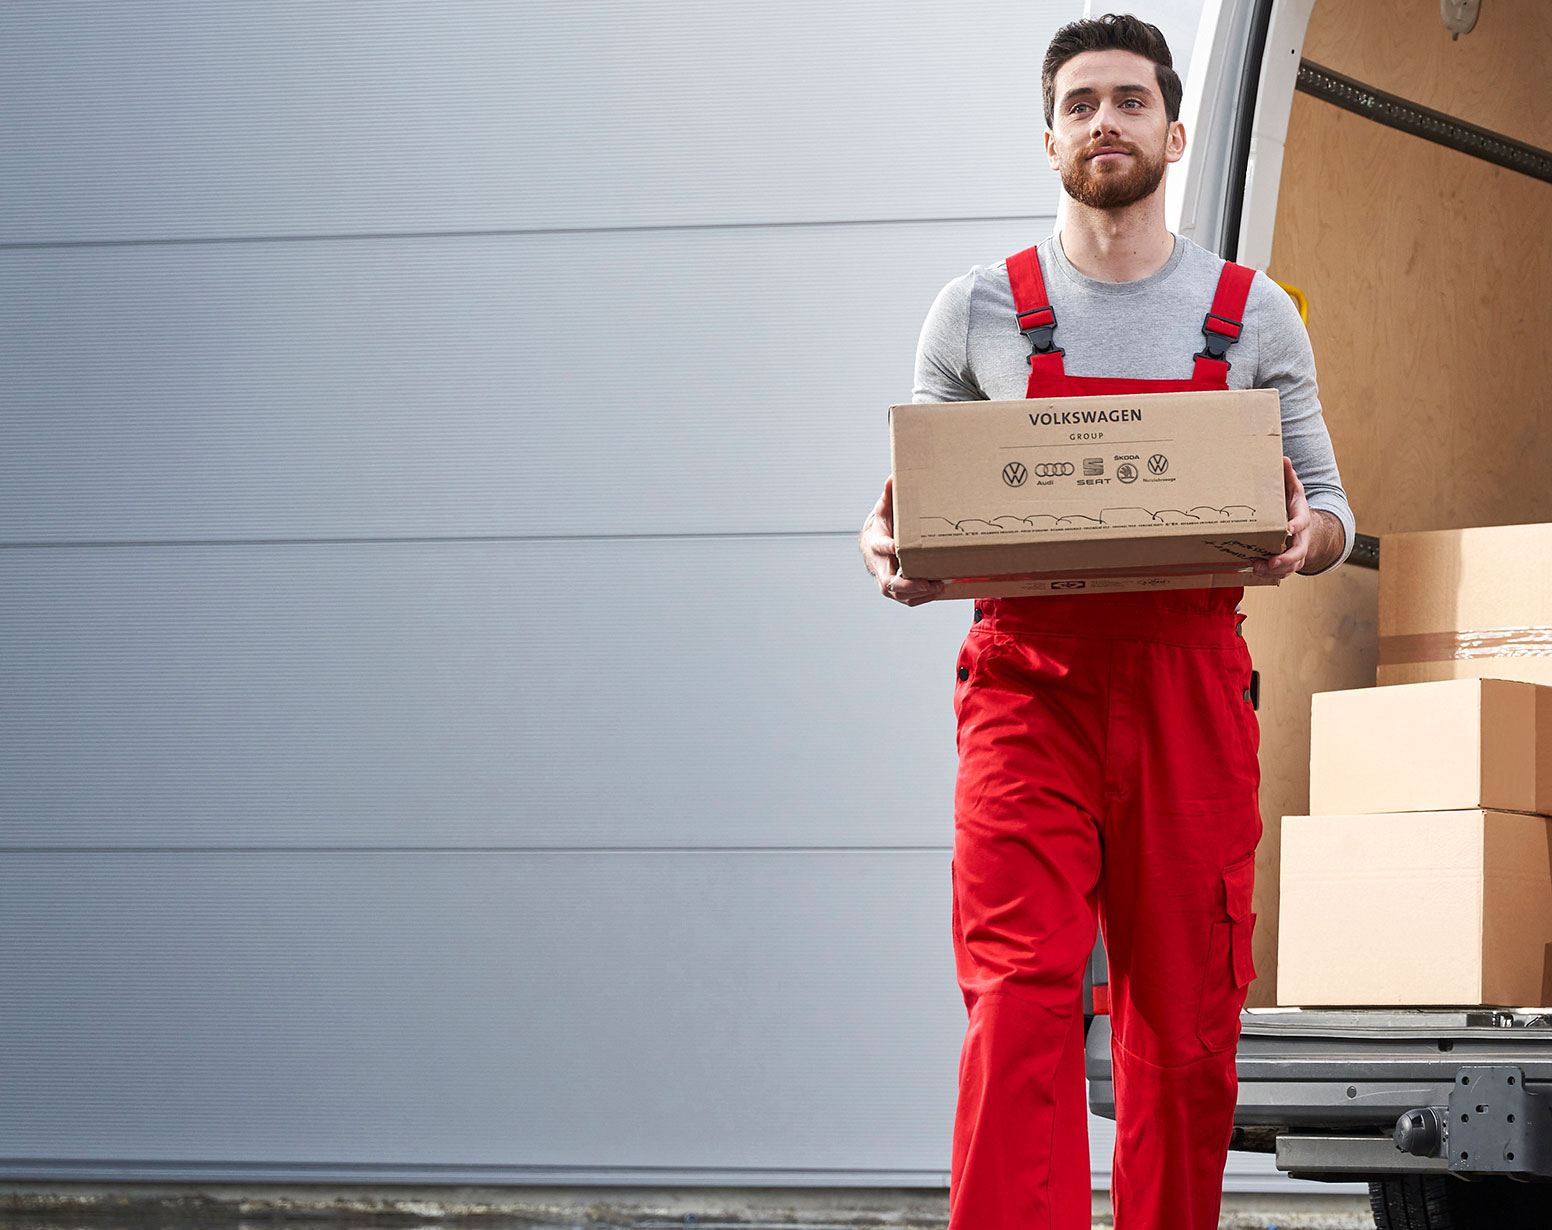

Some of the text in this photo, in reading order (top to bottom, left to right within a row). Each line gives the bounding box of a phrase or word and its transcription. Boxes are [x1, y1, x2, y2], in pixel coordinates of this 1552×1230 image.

[1029, 408, 1142, 426] VOLKSWAGEN
[1069, 432, 1104, 441] GROUP
[1076, 478, 1112, 486] SEAT
